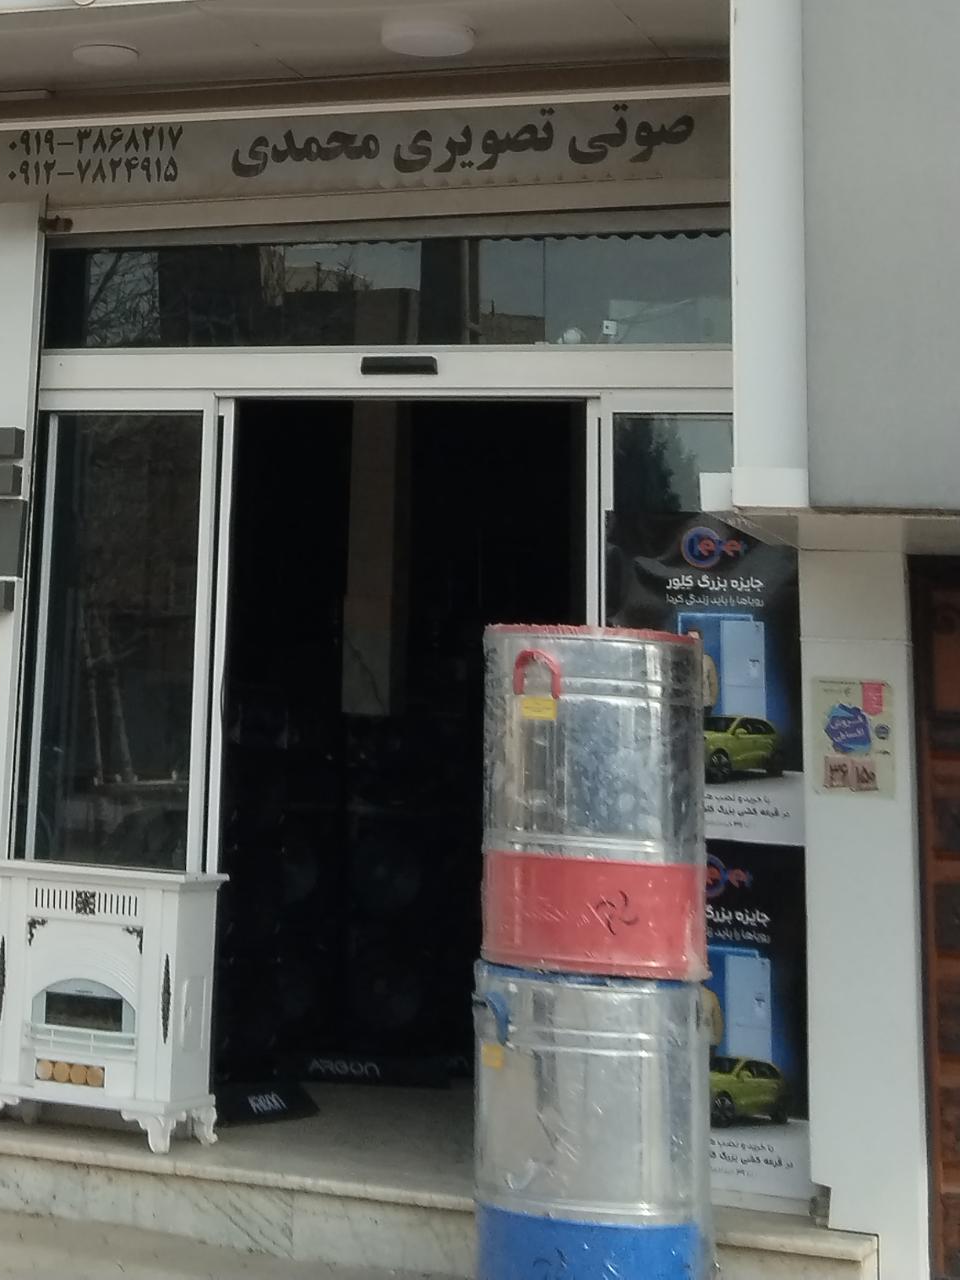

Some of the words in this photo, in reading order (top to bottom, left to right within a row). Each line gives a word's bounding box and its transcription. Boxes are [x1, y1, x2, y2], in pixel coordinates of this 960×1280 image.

[393, 107, 554, 173] تصویری
[568, 103, 695, 164] صوتی
[231, 128, 380, 178] محمدی
[697, 574, 728, 592] بزرگ
[731, 576, 765, 593] جایزه
[735, 908, 771, 928] جایزه
